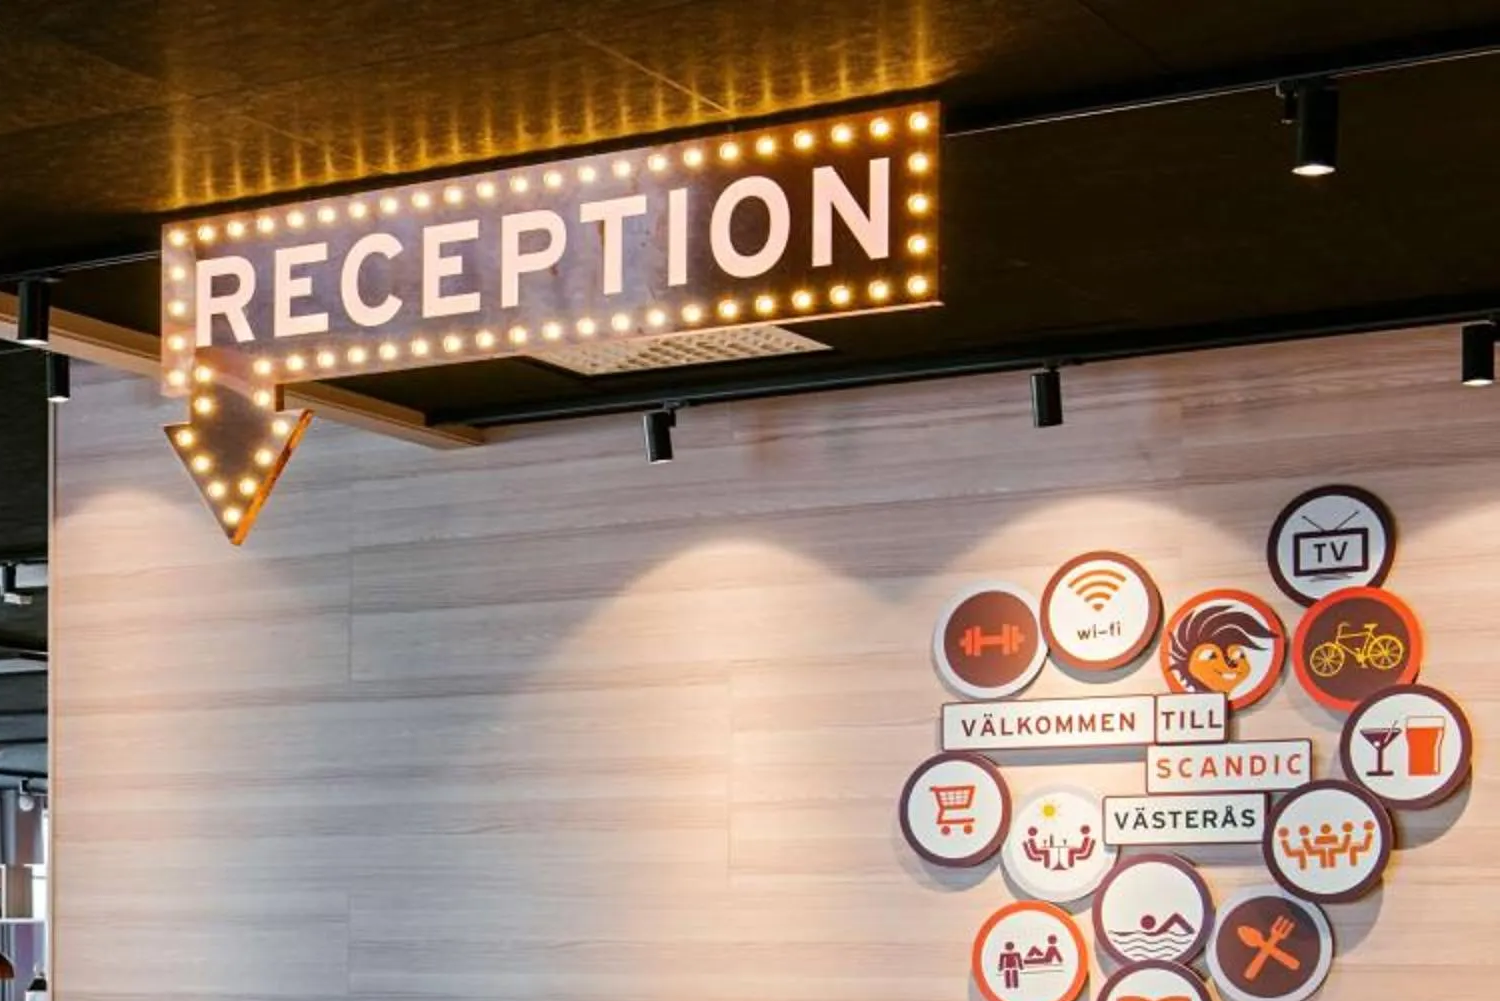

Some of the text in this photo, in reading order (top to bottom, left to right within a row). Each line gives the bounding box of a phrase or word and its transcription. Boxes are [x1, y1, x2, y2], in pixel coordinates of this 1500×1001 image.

[194, 156, 891, 346] RECEPTION
[1312, 541, 1348, 563] TV
[1076, 621, 1121, 641] wi-fi
[961, 709, 1222, 737] VÄLKOMMEN TILL
[1155, 752, 1302, 780] SCANDIC
[1114, 805, 1256, 830] VÄSTERÅS
